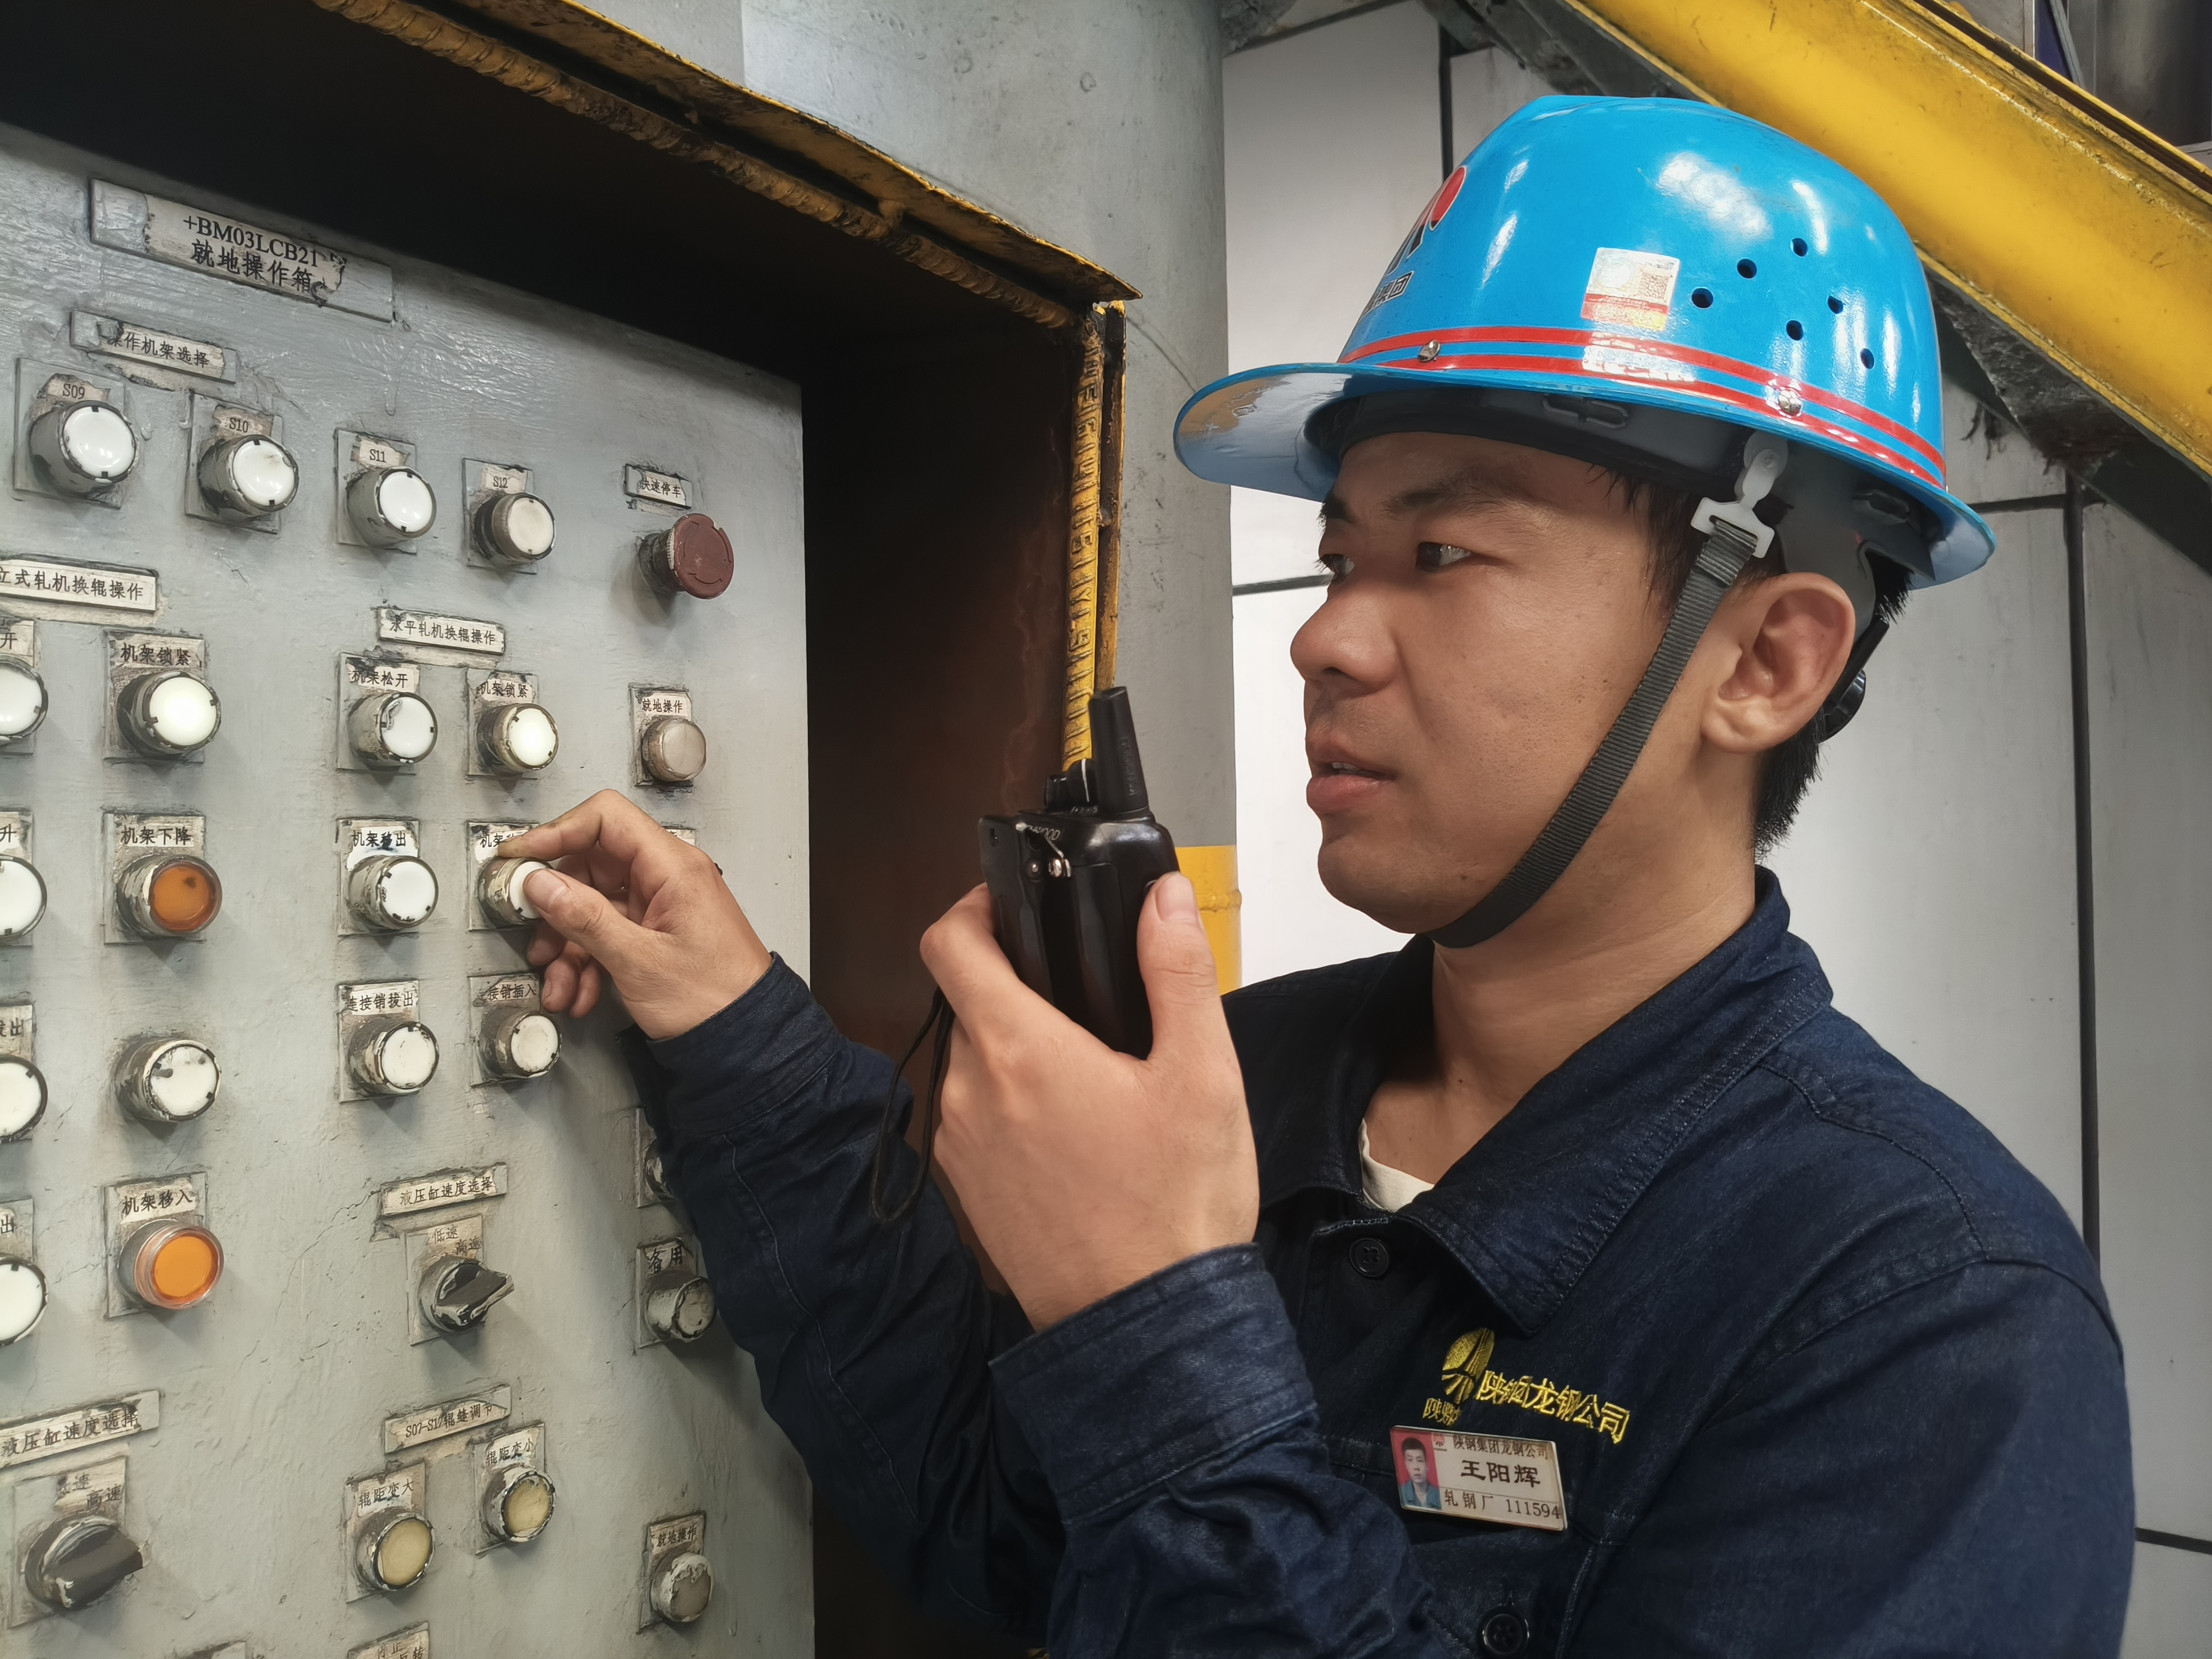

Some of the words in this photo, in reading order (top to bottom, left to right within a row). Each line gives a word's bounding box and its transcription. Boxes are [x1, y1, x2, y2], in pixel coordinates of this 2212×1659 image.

[184, 215, 319, 268] +BM03LCB21
[190, 238, 313, 293] 就地操作箱
[62, 383, 85, 400] S09
[229, 417, 249, 433] S10
[369, 448, 387, 463] S11
[493, 476, 508, 489] S12
[0, 566, 144, 601] 立式轧机换辊操作
[0, 632, 18, 650] 开
[389, 619, 496, 646] 水平轧机换辊操作
[120, 642, 191, 666] 机架锁紧
[642, 698, 683, 713] 就地操作
[120, 825, 192, 846] 机架下降
[351, 830, 407, 849] 机架移出
[476, 833, 514, 848] 机架
[479, 983, 537, 1002] 接销插入
[400, 1176, 493, 1205] 液压缸速度选择
[122, 1189, 193, 1216] 机架移入
[434, 1224, 459, 1244] 低速
[456, 1236, 481, 1256] 高速
[485, 1438, 534, 1466] 辊距变小
[1461, 1460, 1541, 1488] 王阳辉
[358, 1478, 414, 1509] 辊距变大
[1506, 1499, 1562, 1519] 111594
